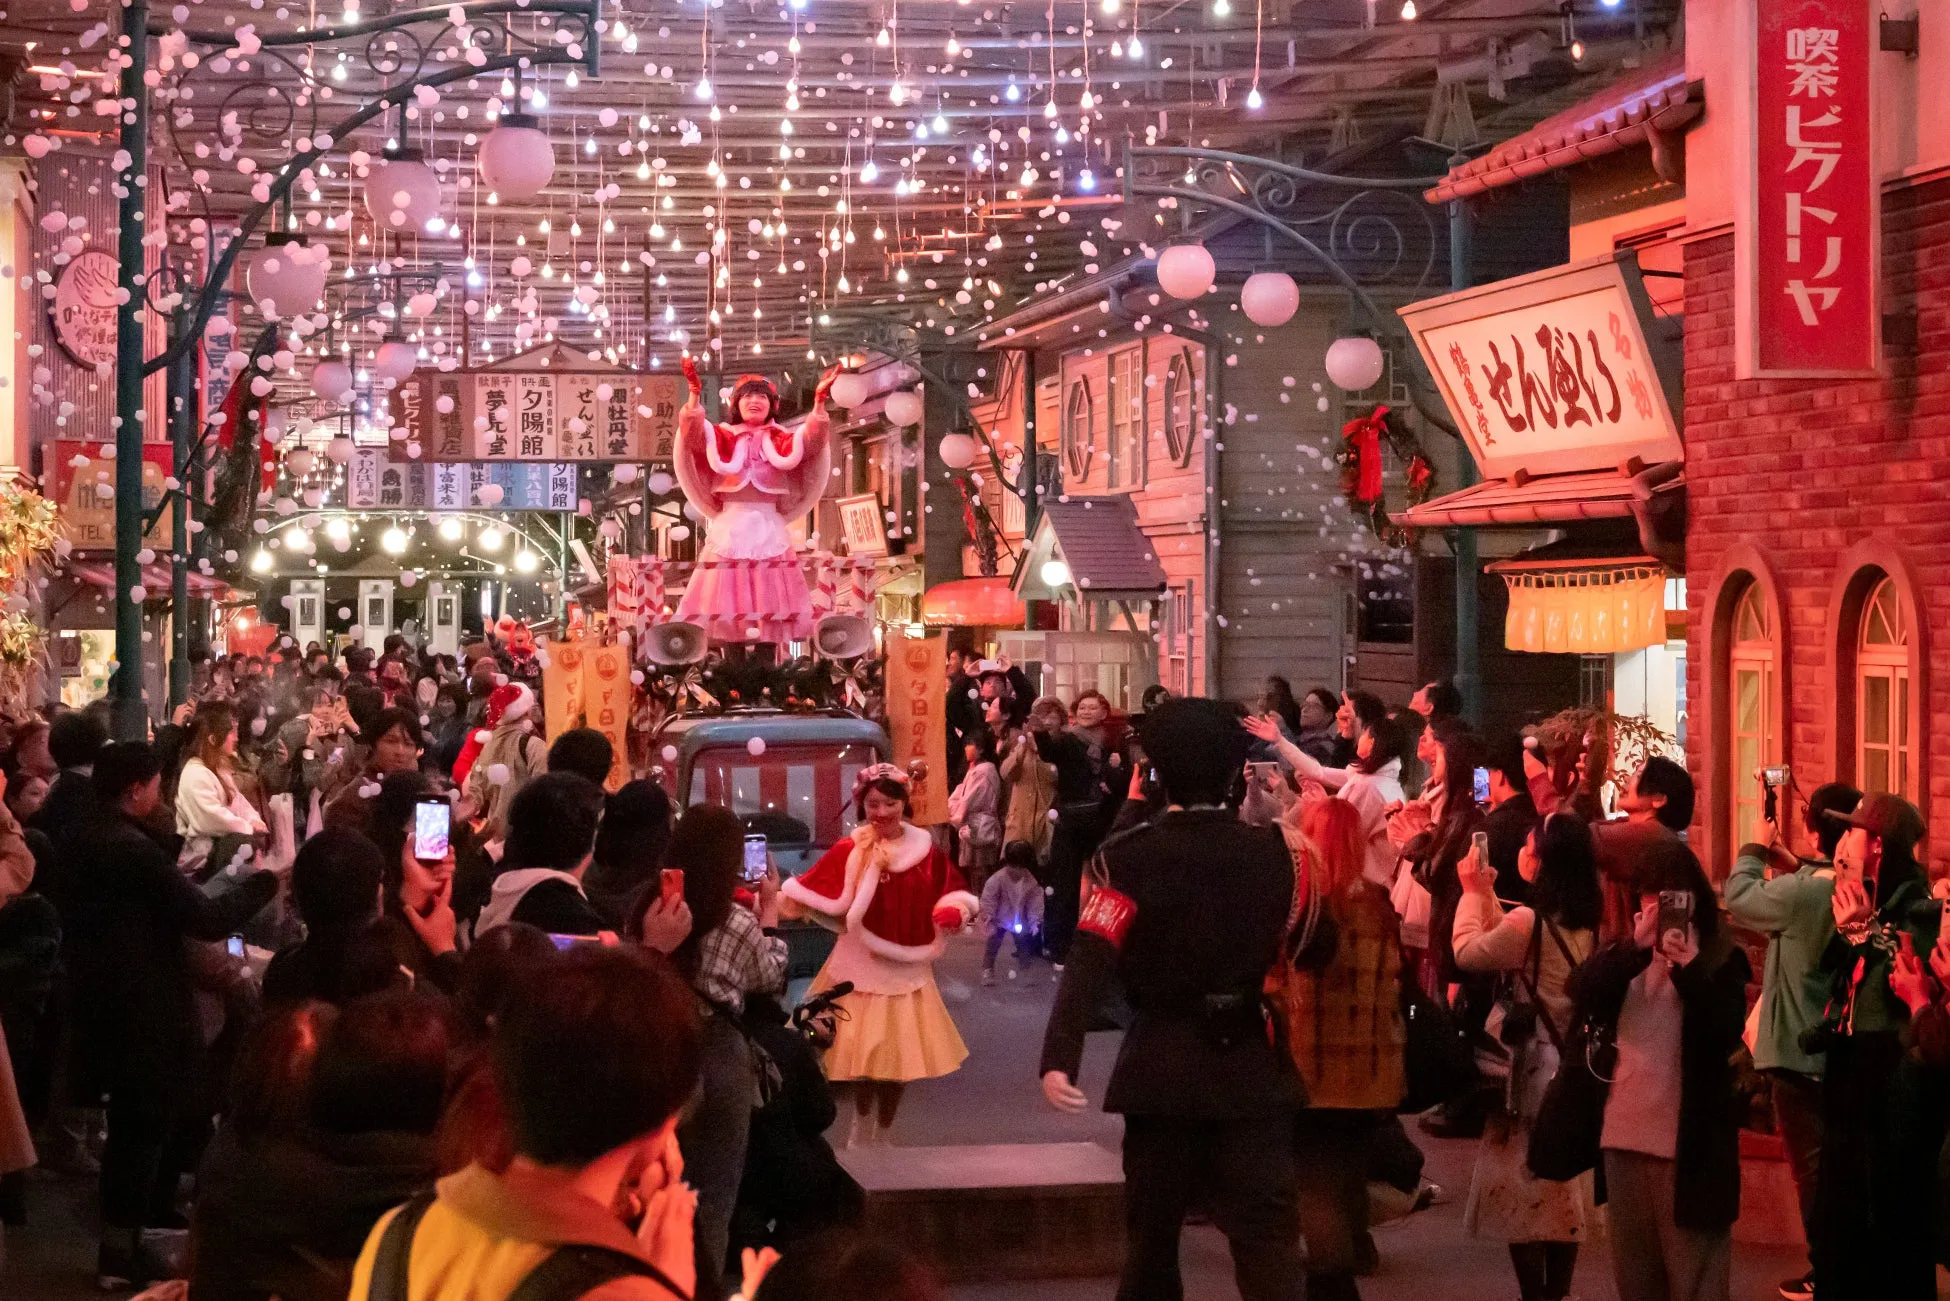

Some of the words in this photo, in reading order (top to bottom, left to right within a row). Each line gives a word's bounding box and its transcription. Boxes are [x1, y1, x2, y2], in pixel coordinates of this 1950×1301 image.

[1784, 27, 1843, 326] 喫茶ビクトリヤ
[521, 389, 544, 456] 夕陽館
[655, 401, 674, 456] 助六屋
[79, 525, 105, 540] TEL
